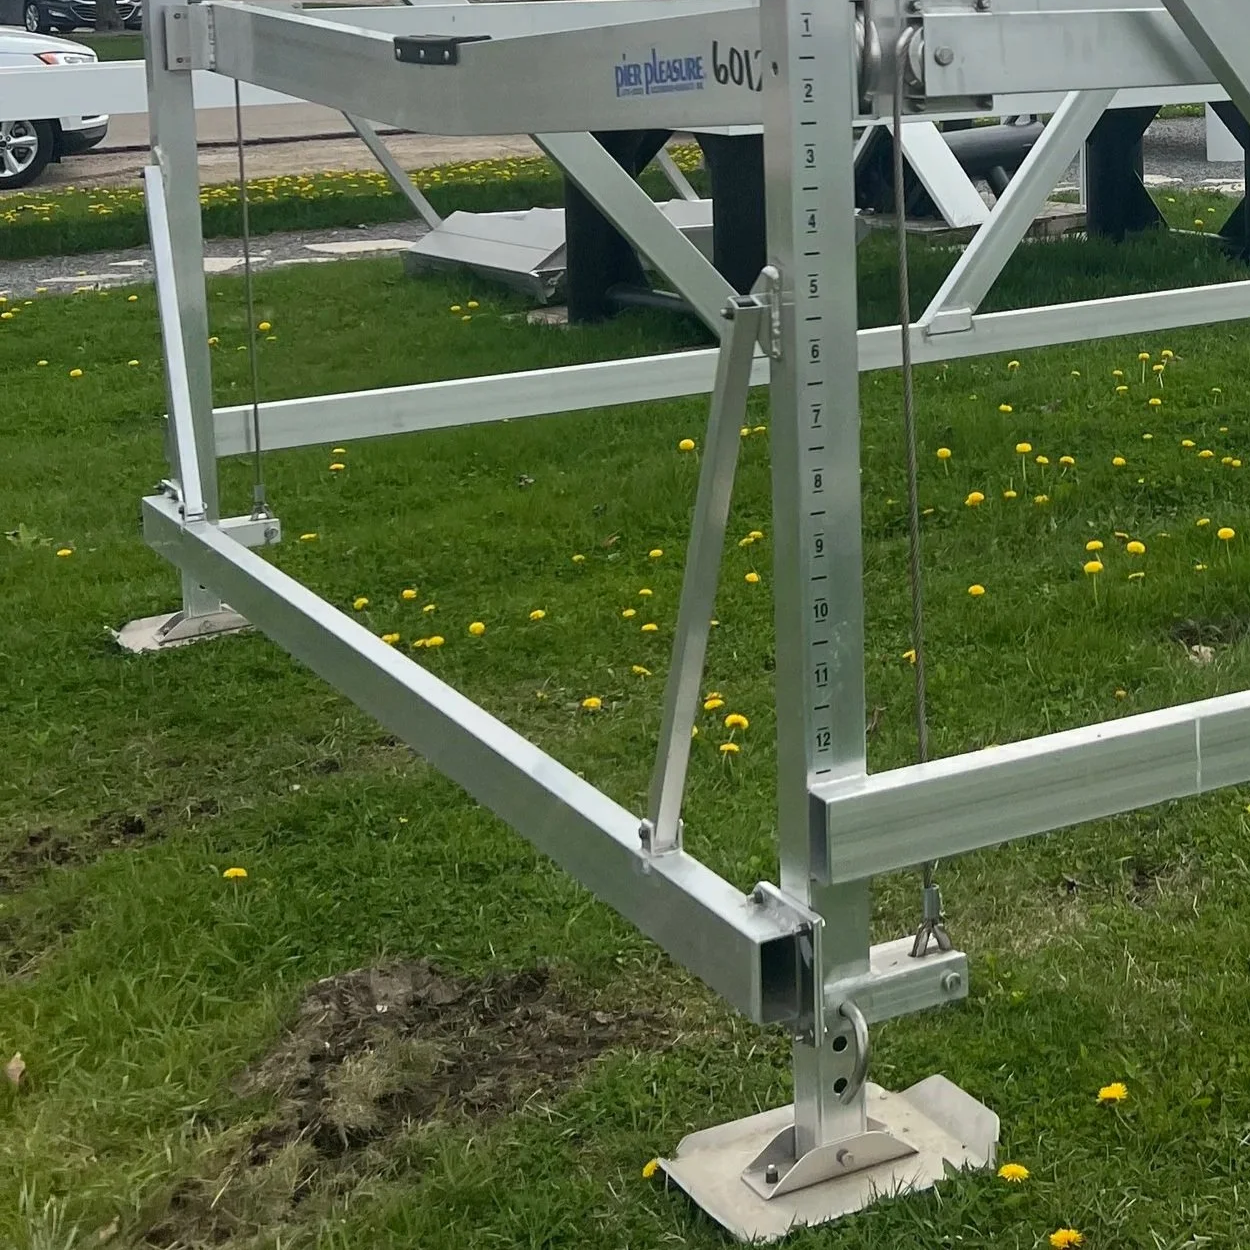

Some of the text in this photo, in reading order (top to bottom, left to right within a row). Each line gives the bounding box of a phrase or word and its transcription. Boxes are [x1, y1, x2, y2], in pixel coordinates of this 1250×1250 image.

[803, 18, 810, 32] 1
[804, 83, 812, 98] 2
[806, 148, 815, 164] 3
[807, 213, 816, 228] 4
[809, 279, 818, 294] 5
[811, 344, 820, 359] 6
[812, 409, 821, 424] 7
[813, 473, 822, 489] 8
[815, 538, 824, 553] 9
[813, 602, 829, 619] 10
[814, 667, 829, 683] 11
[816, 731, 831, 748] 12
